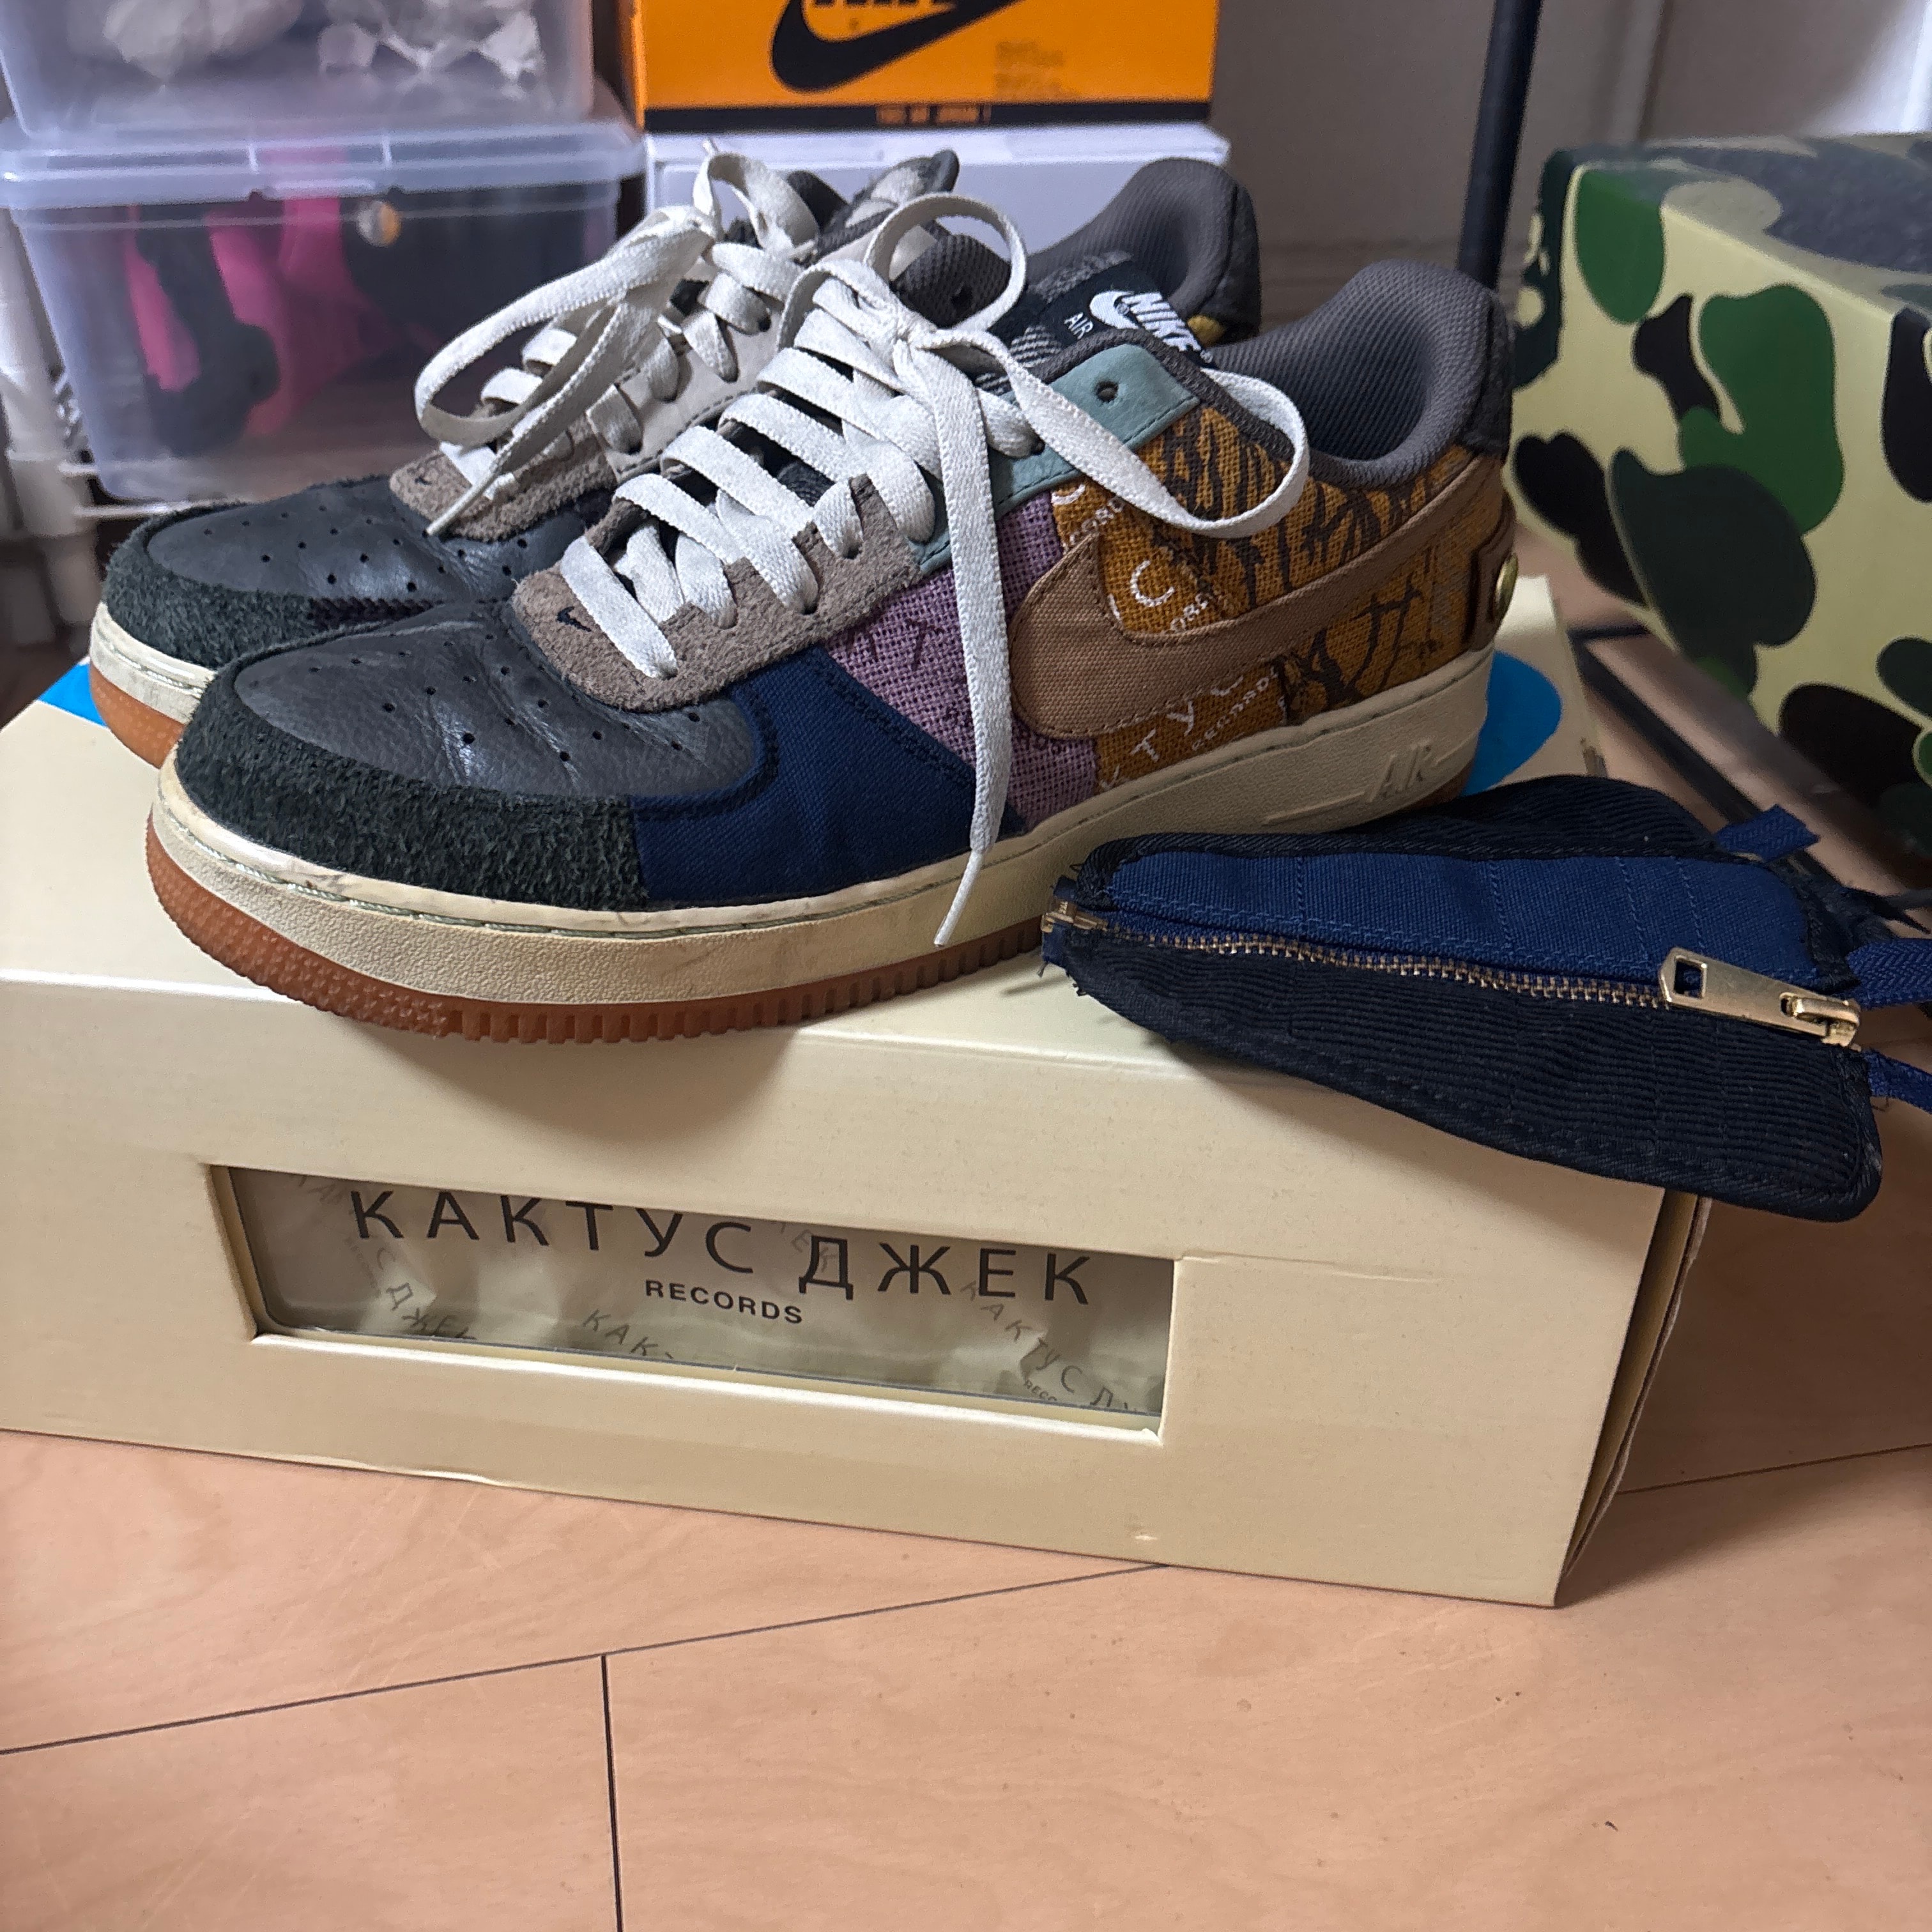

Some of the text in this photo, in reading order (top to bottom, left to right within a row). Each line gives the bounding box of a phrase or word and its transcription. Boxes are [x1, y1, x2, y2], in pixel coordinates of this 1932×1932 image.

[1063, 311, 1094, 340] AIR
[350, 1190, 755, 1275] КАКТУС
[798, 1234, 1090, 1307] ДЖЕК
[645, 1279, 803, 1324] RECORDS
